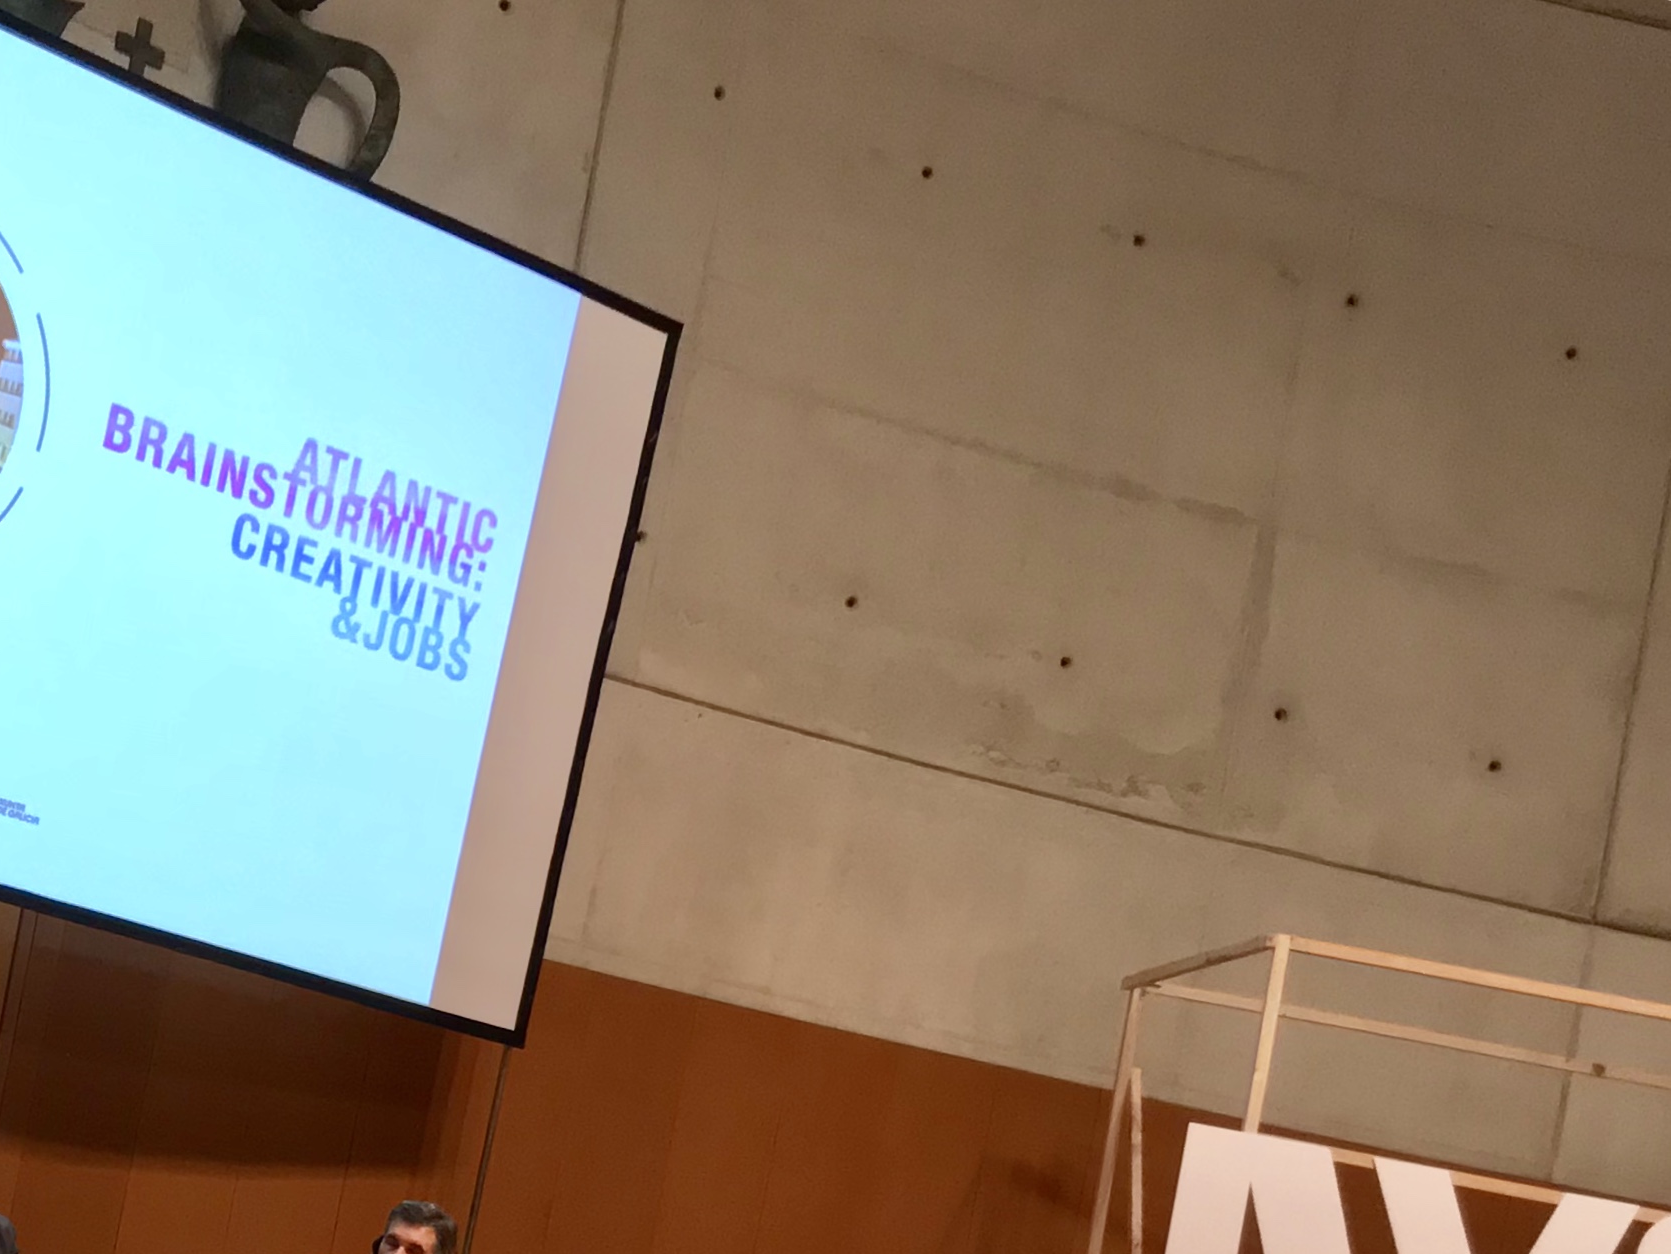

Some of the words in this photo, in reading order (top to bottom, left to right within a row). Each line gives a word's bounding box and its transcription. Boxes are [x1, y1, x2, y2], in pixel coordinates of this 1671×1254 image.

[102, 402, 487, 592] BRAINSTORMING:
[292, 436, 498, 554] ATLANTIC
[230, 512, 481, 640] CREATIVITY
[330, 596, 471, 682] &JOBS
[7, 809, 41, 826] GALICIA
